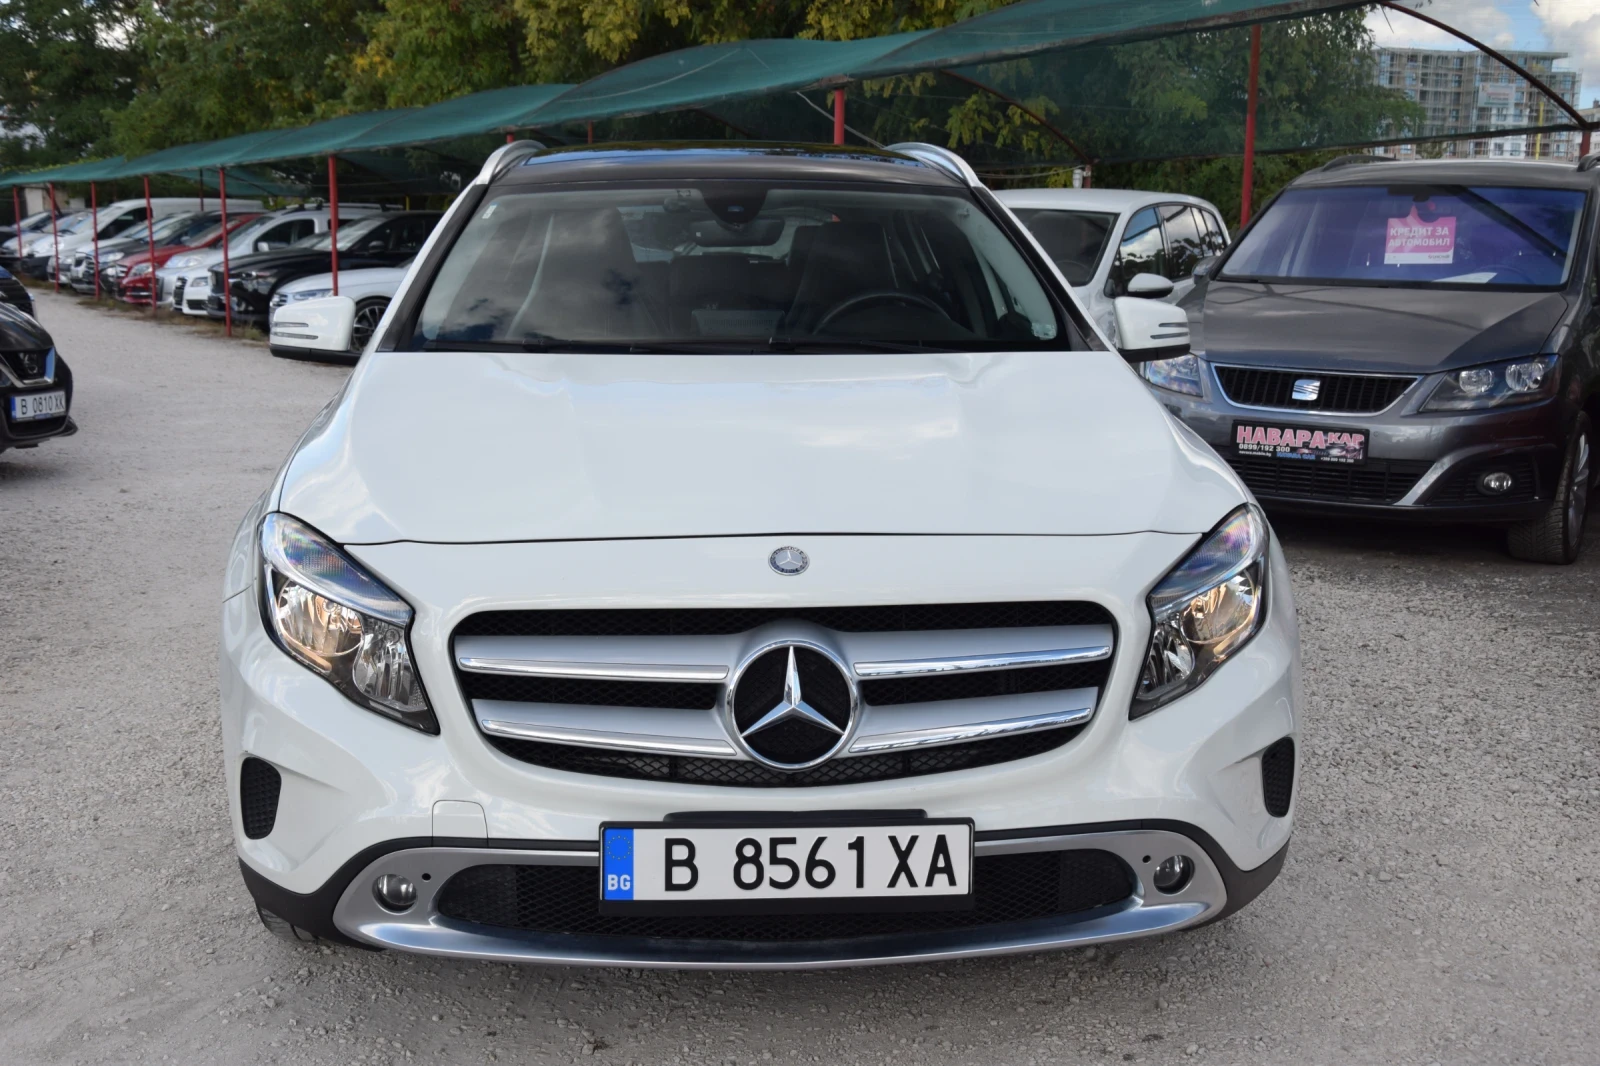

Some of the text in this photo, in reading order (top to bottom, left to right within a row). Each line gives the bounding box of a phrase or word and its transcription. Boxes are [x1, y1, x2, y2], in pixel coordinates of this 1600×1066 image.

[1390, 227, 1449, 238] КРЕДИТ ЗА
[1388, 238, 1450, 246] АВТОМОБИЛ
[21, 398, 28, 415] B
[33, 396, 53, 413] 0810
[1236, 426, 1364, 449] НАВАРА КАР
[664, 834, 957, 892] B 8561 XA
[607, 874, 631, 891] BG
